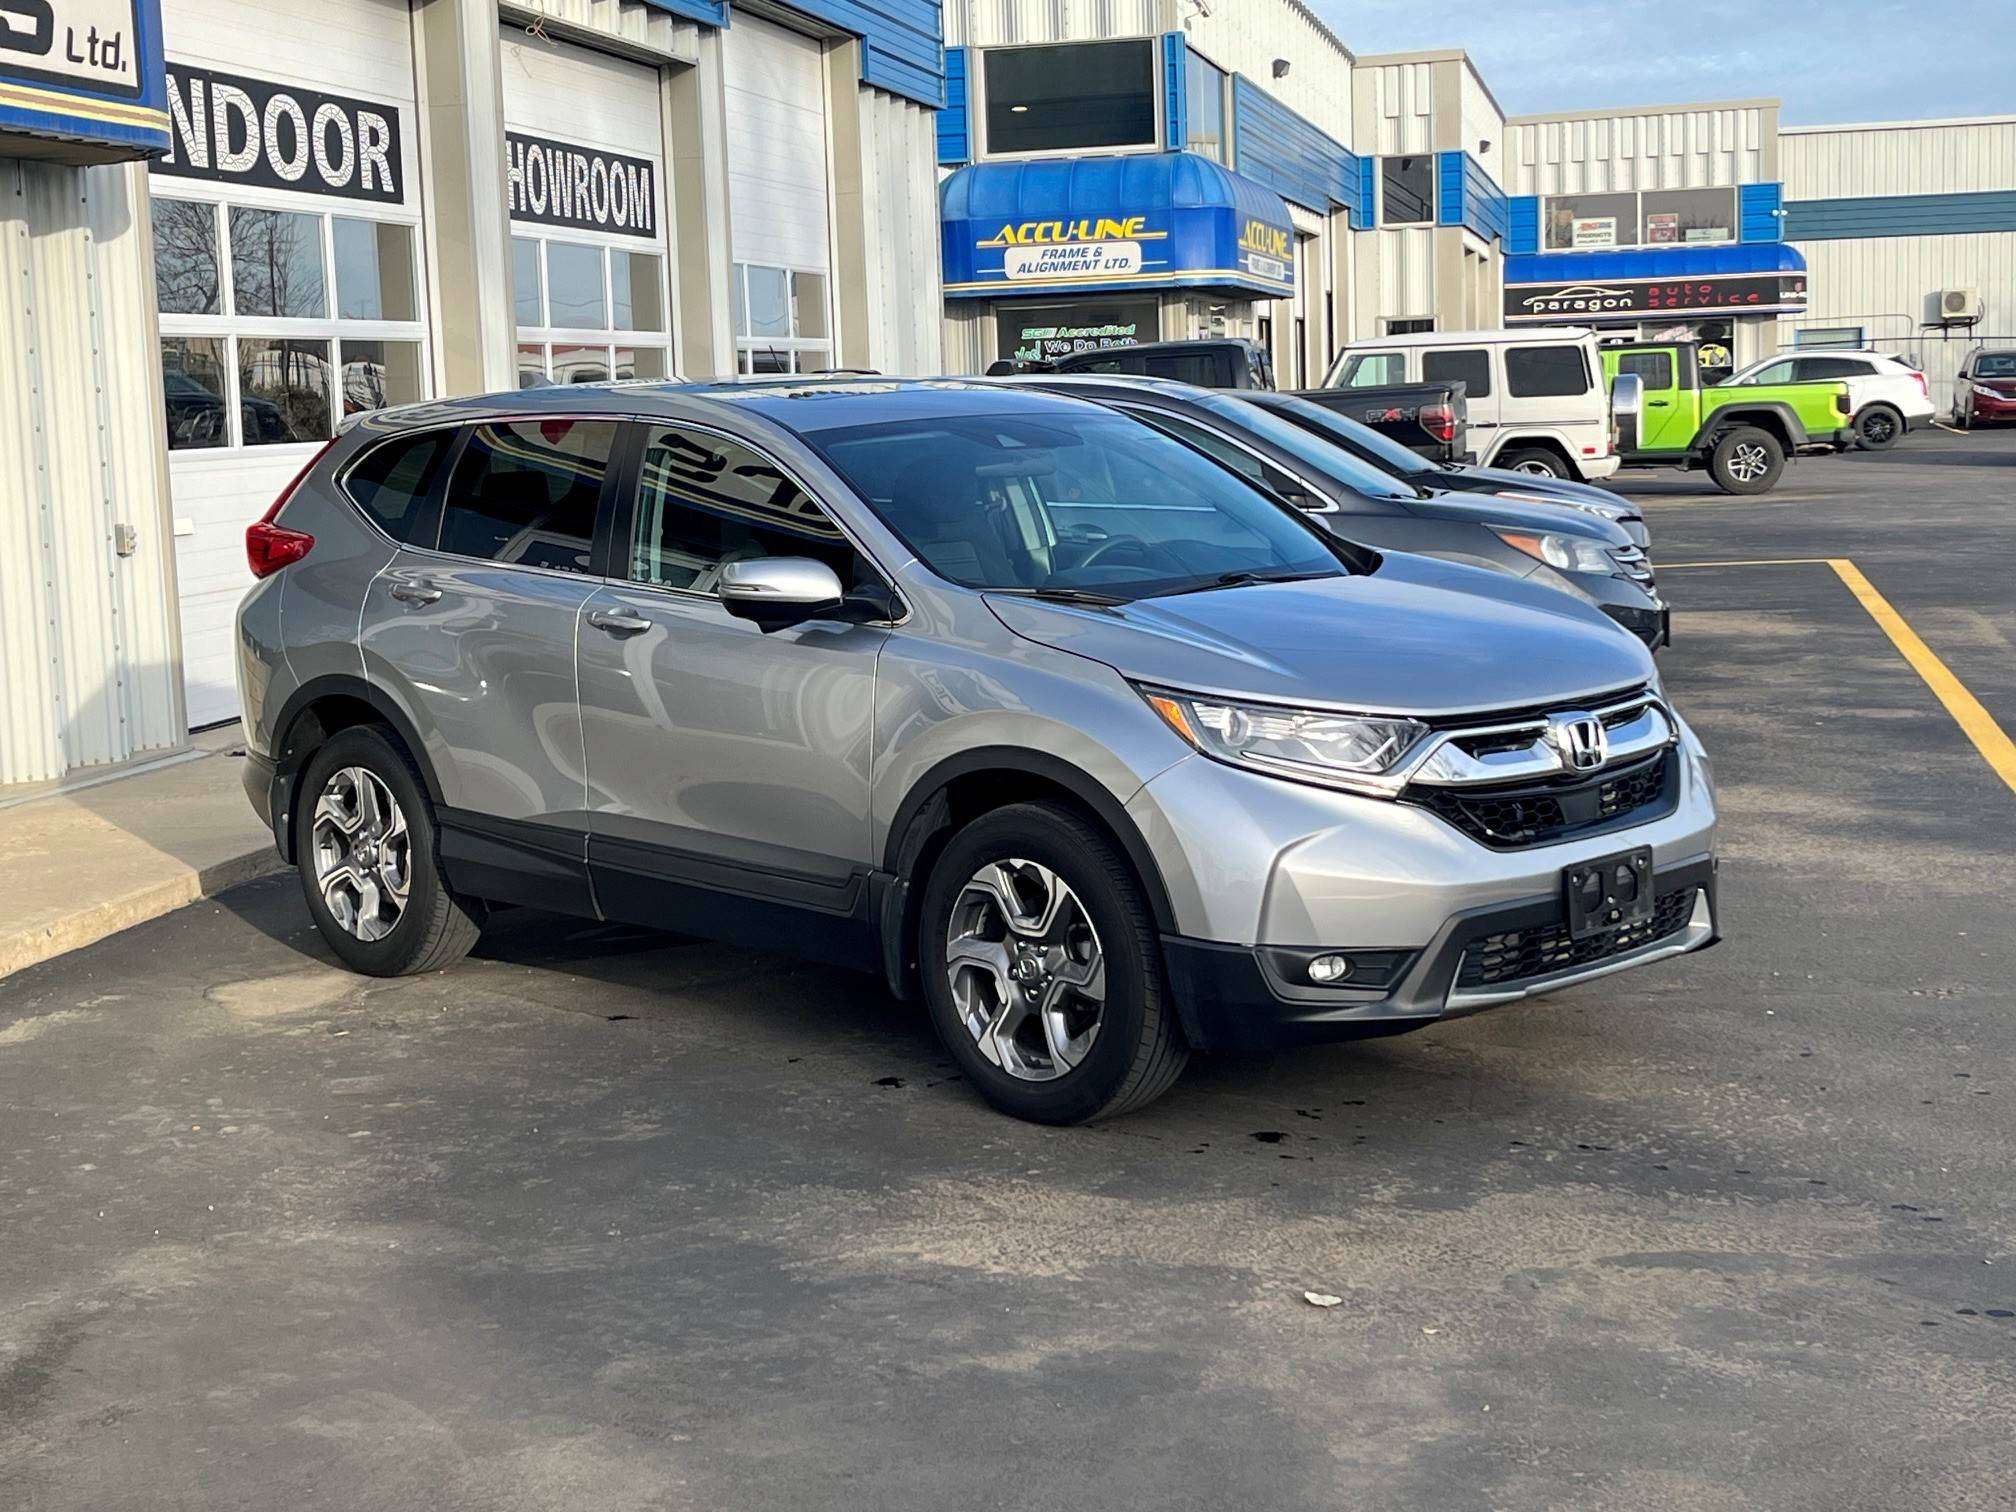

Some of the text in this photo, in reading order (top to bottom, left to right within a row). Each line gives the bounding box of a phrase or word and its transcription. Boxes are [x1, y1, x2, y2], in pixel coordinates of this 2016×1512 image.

[66, 26, 127, 72] Ltd.
[161, 73, 395, 193] NDOOR
[505, 140, 651, 230] HOWROOM
[992, 216, 1147, 245] ACCU-LINE
[1041, 246, 1103, 260] FRAME &
[1017, 257, 1132, 274] ALIGNMENT LTD.
[1648, 284, 1712, 297] auto
[1532, 296, 1633, 313] paragon
[1056, 323, 1136, 338] Accredited
[1044, 340, 1071, 354] We
[1073, 339, 1098, 352] Do
